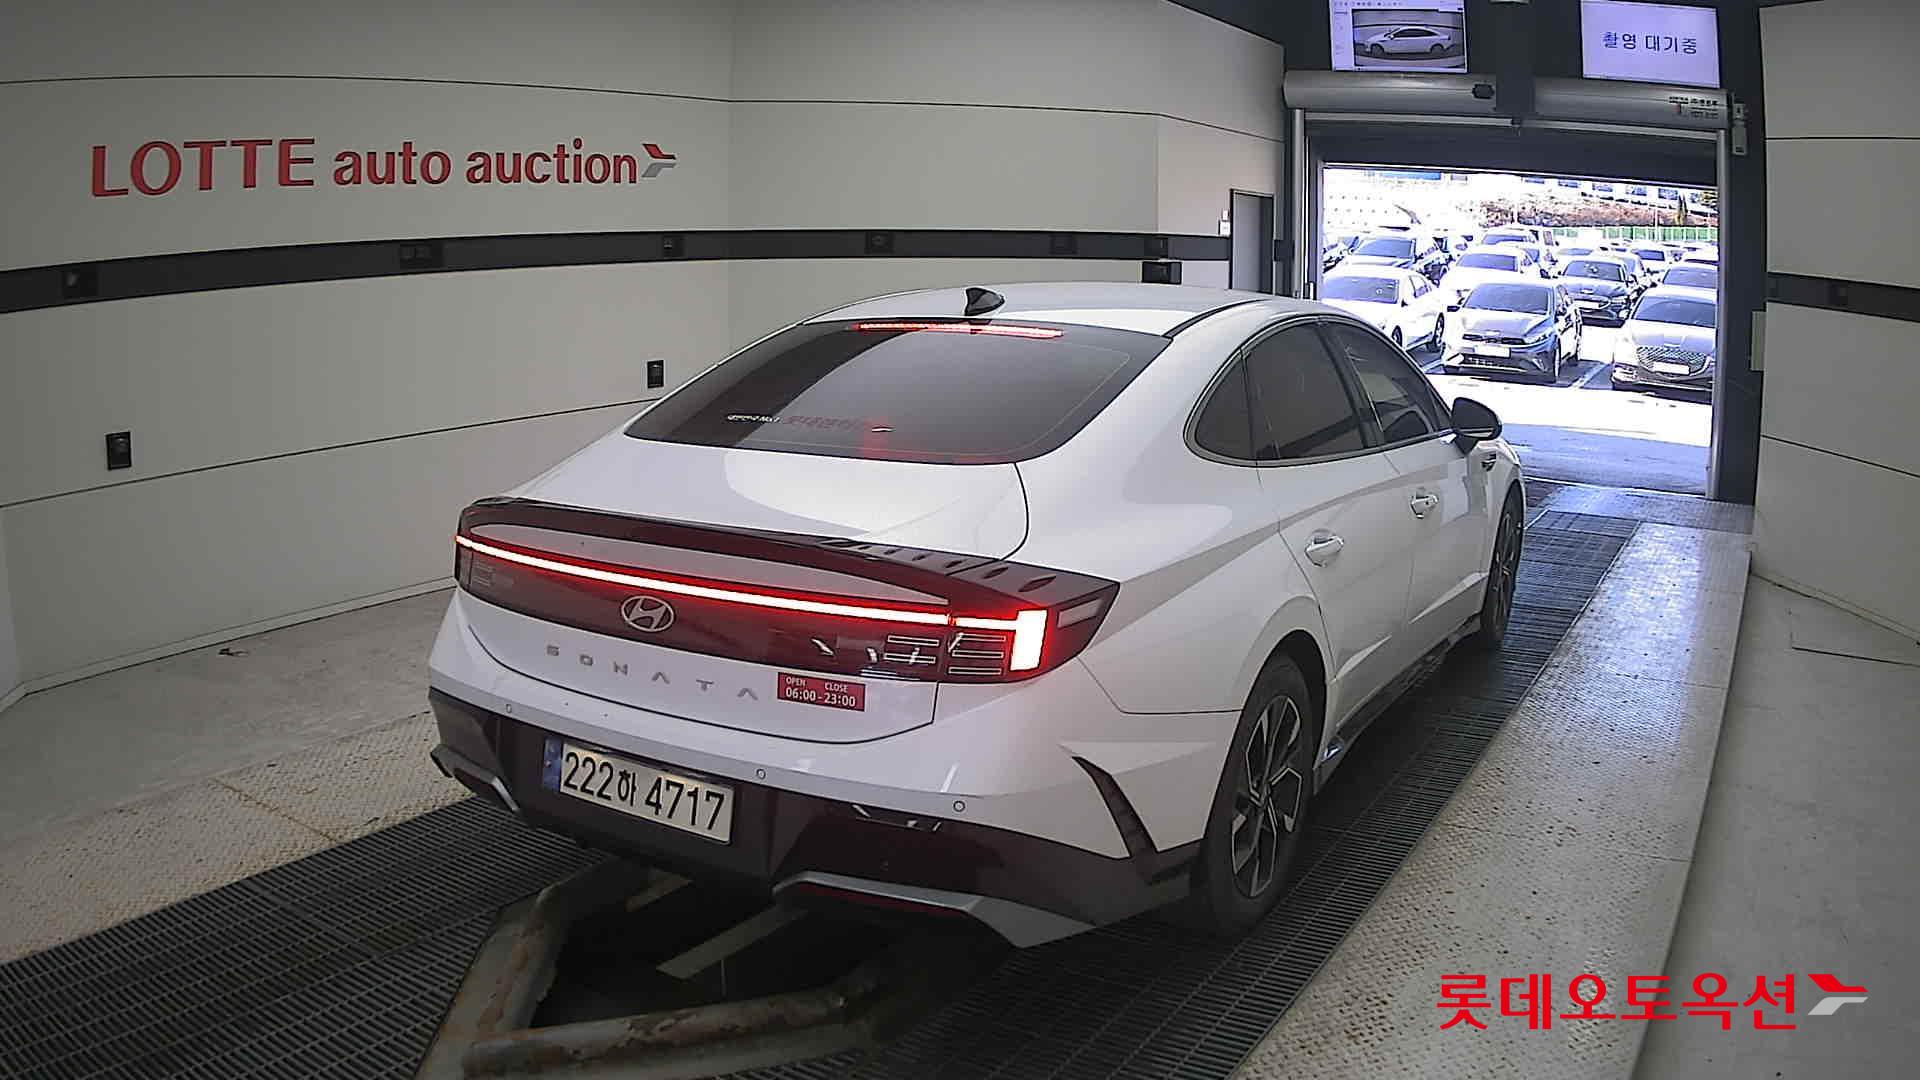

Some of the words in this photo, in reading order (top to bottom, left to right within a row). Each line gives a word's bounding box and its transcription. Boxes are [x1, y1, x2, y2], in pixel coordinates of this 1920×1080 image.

[1644, 34, 1697, 55] 대기중
[91, 138, 316, 198] LOTTE
[332, 141, 452, 187] auto
[465, 137, 639, 187] auction
[546, 645, 759, 701] SONATA
[785, 676, 807, 688] OPEN
[824, 681, 849, 694] CLOSE
[563, 751, 638, 807] 222하
[645, 775, 725, 831] 4717
